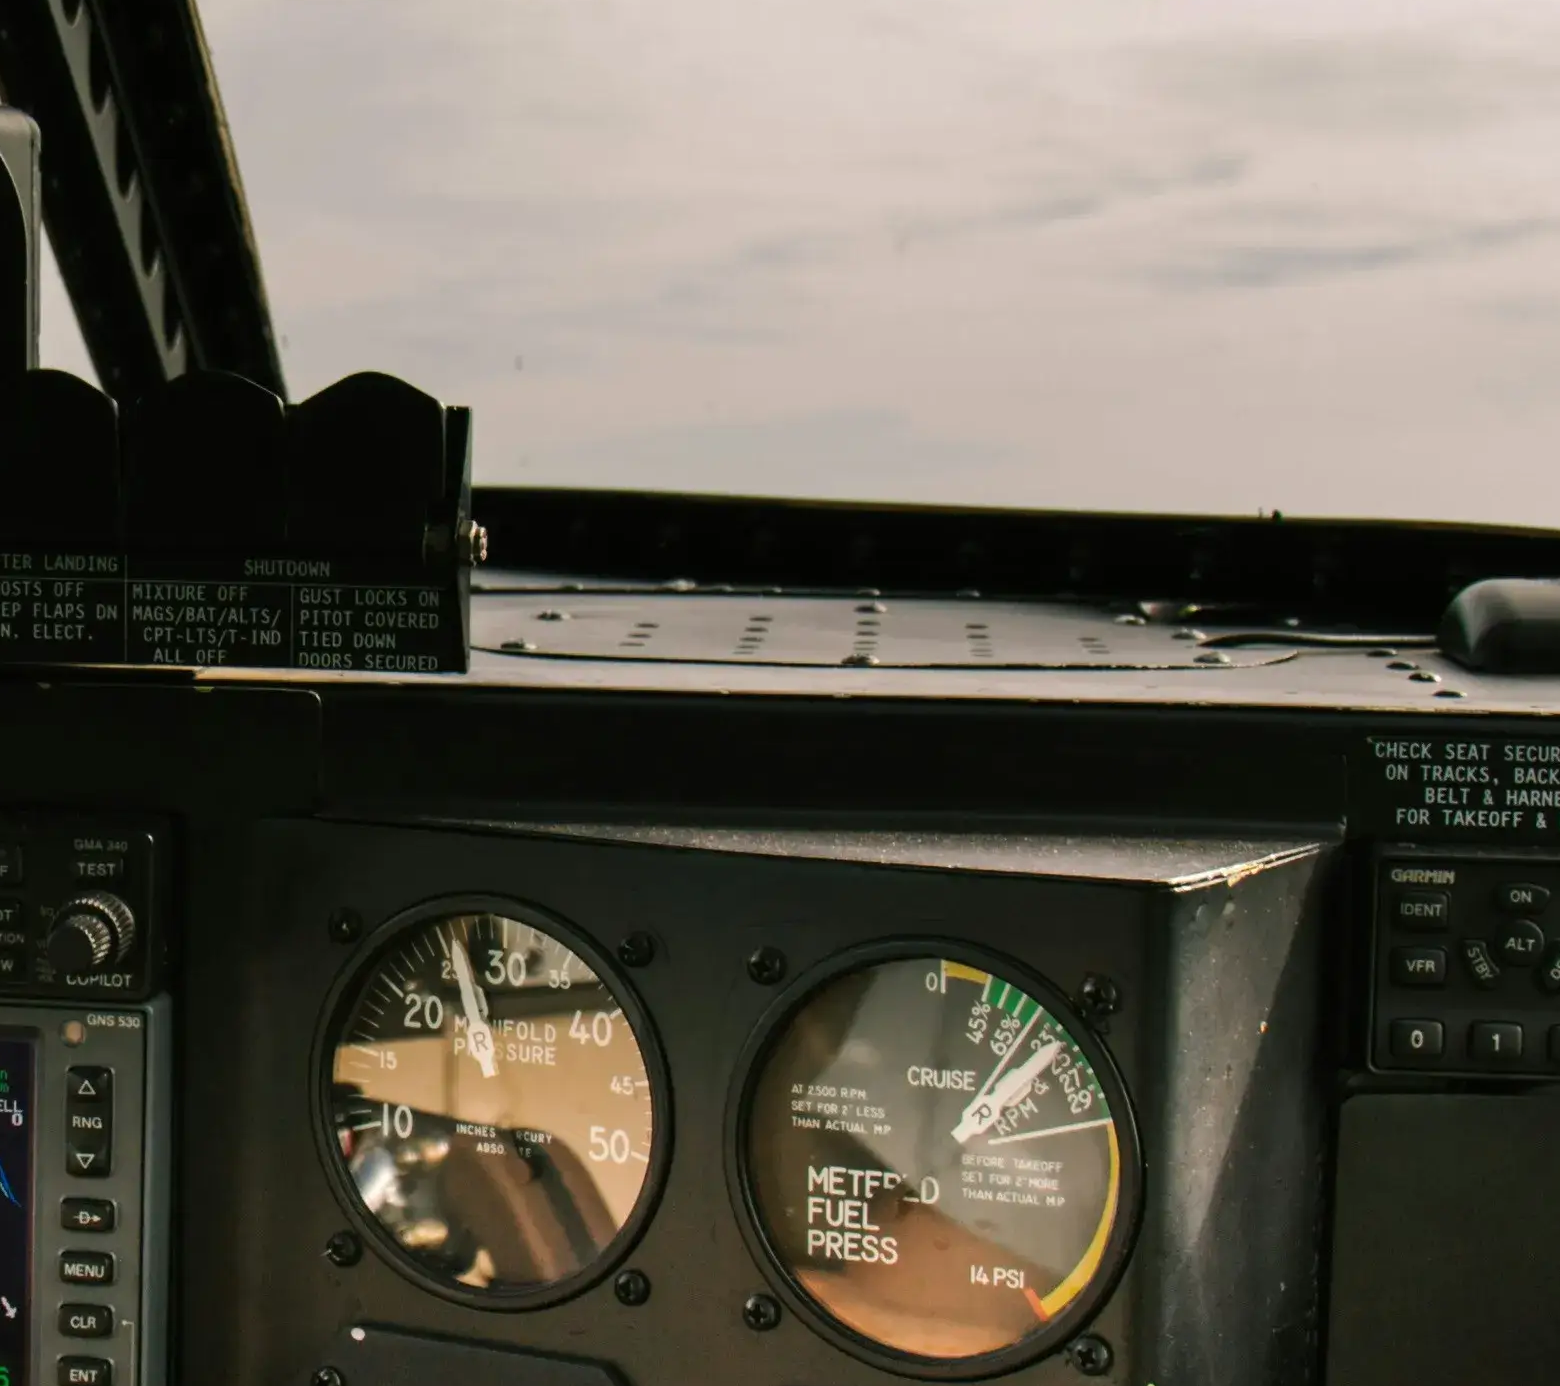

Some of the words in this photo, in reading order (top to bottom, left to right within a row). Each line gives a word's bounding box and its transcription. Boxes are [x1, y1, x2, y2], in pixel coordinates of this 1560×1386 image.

[244, 559, 330, 578] SHUTDOWN
[51, 581, 85, 598] OFF
[299, 587, 347, 605] GUST
[355, 589, 410, 606] LOCKS
[417, 590, 439, 607] ON
[299, 609, 353, 627] PITOT
[362, 611, 439, 629] COVERED
[298, 653, 355, 669] DOORS
[363, 654, 438, 672] SECURED
[1375, 742, 1432, 760] CHECK
[1444, 743, 1490, 761] SEAT
[1386, 765, 1408, 781] ON
[1420, 766, 1500, 786] TRACKS,
[1513, 767, 1560, 785] BACK
[1425, 788, 1471, 804] BELT
[1483, 789, 1493, 805] &
[1396, 809, 1431, 826] FOR
[1442, 810, 1525, 828] TAKEOFF
[1536, 813, 1547, 828] &
[77, 862, 116, 876] TEST
[1391, 868, 1455, 885] GARMIN
[1399, 899, 1443, 919] IDENT
[486, 949, 527, 987] 30
[1405, 957, 1436, 974] VFR
[404, 992, 445, 1030] 20
[569, 1018, 613, 1048] 40
[1411, 1031, 1422, 1048] 0
[907, 1066, 976, 1092] CRUISE
[72, 1116, 102, 1129] RNG
[588, 1126, 631, 1163] 50
[807, 1198, 880, 1233] FUEL
[807, 1230, 898, 1266] PRESS
[64, 1263, 104, 1278] MENU
[968, 1265, 988, 1287] 14
[994, 1268, 1025, 1290] PSI
[70, 1314, 97, 1328] CLR
[69, 1368, 97, 1383] ENT
